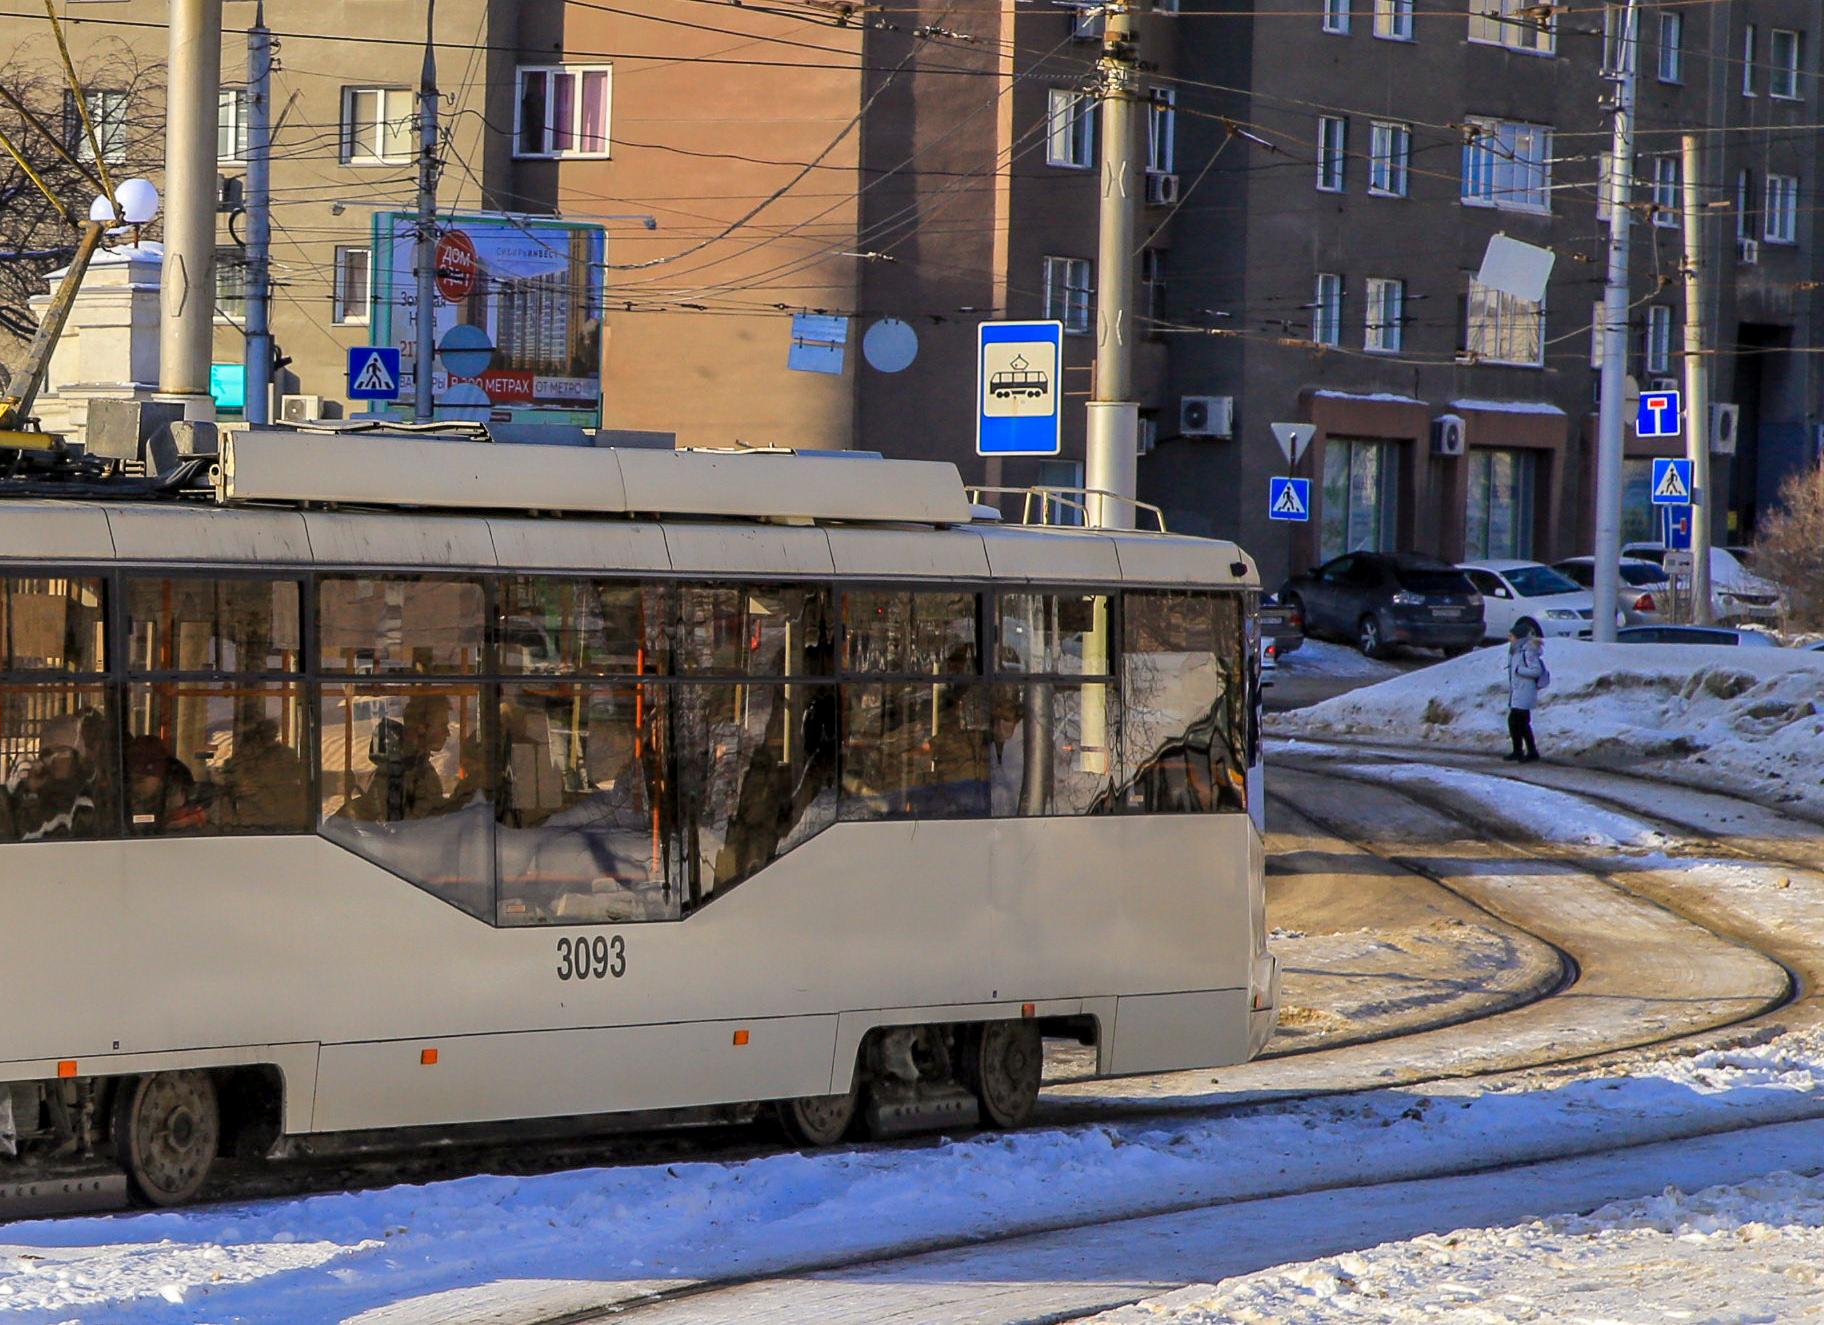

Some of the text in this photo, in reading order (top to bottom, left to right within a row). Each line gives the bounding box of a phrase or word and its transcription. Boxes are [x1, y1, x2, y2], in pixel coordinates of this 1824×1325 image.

[442, 246, 471, 267] ДОМ
[485, 377, 530, 393] МЕТРАХ
[535, 381, 548, 393] ОТ
[550, 381, 582, 394] МЕТРО
[556, 935, 627, 982] 3093
